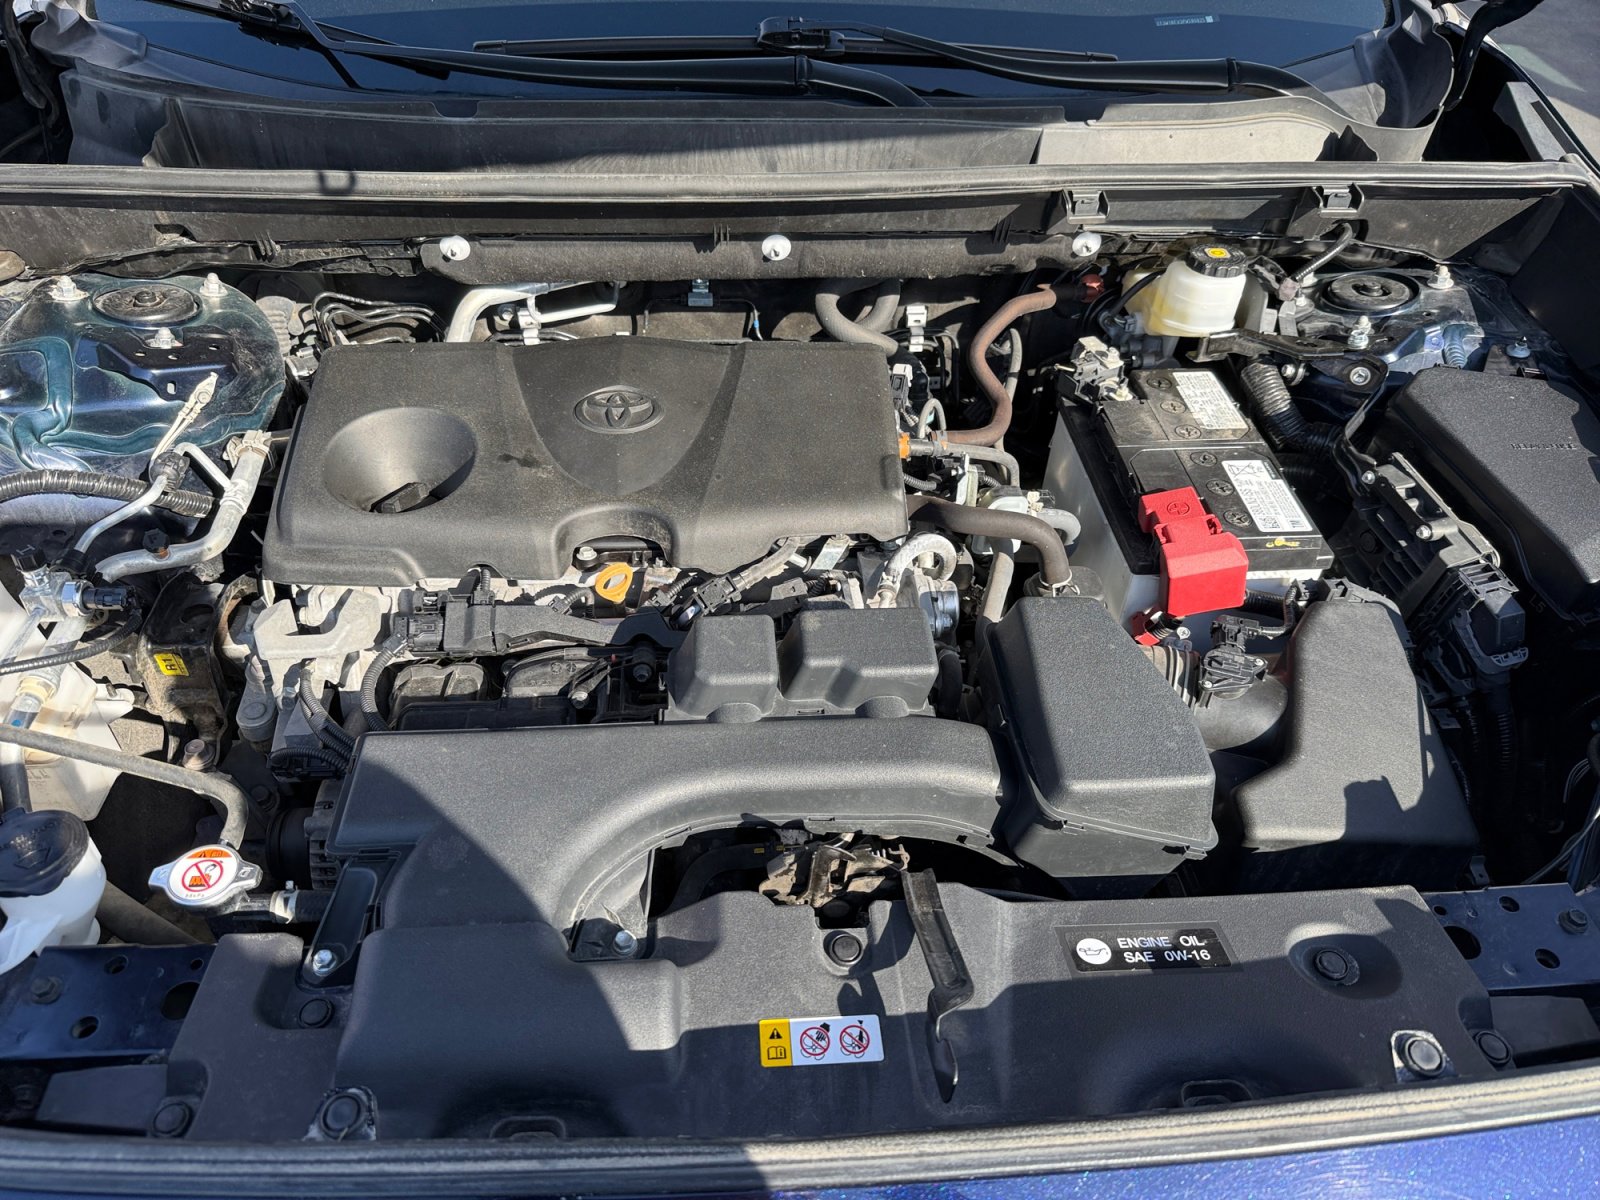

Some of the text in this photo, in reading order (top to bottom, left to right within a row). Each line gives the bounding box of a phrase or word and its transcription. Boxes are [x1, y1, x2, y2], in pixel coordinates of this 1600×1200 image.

[1117, 935, 1205, 949] ENGINE OIL
[1123, 949, 1211, 963] SAE 0W-16
